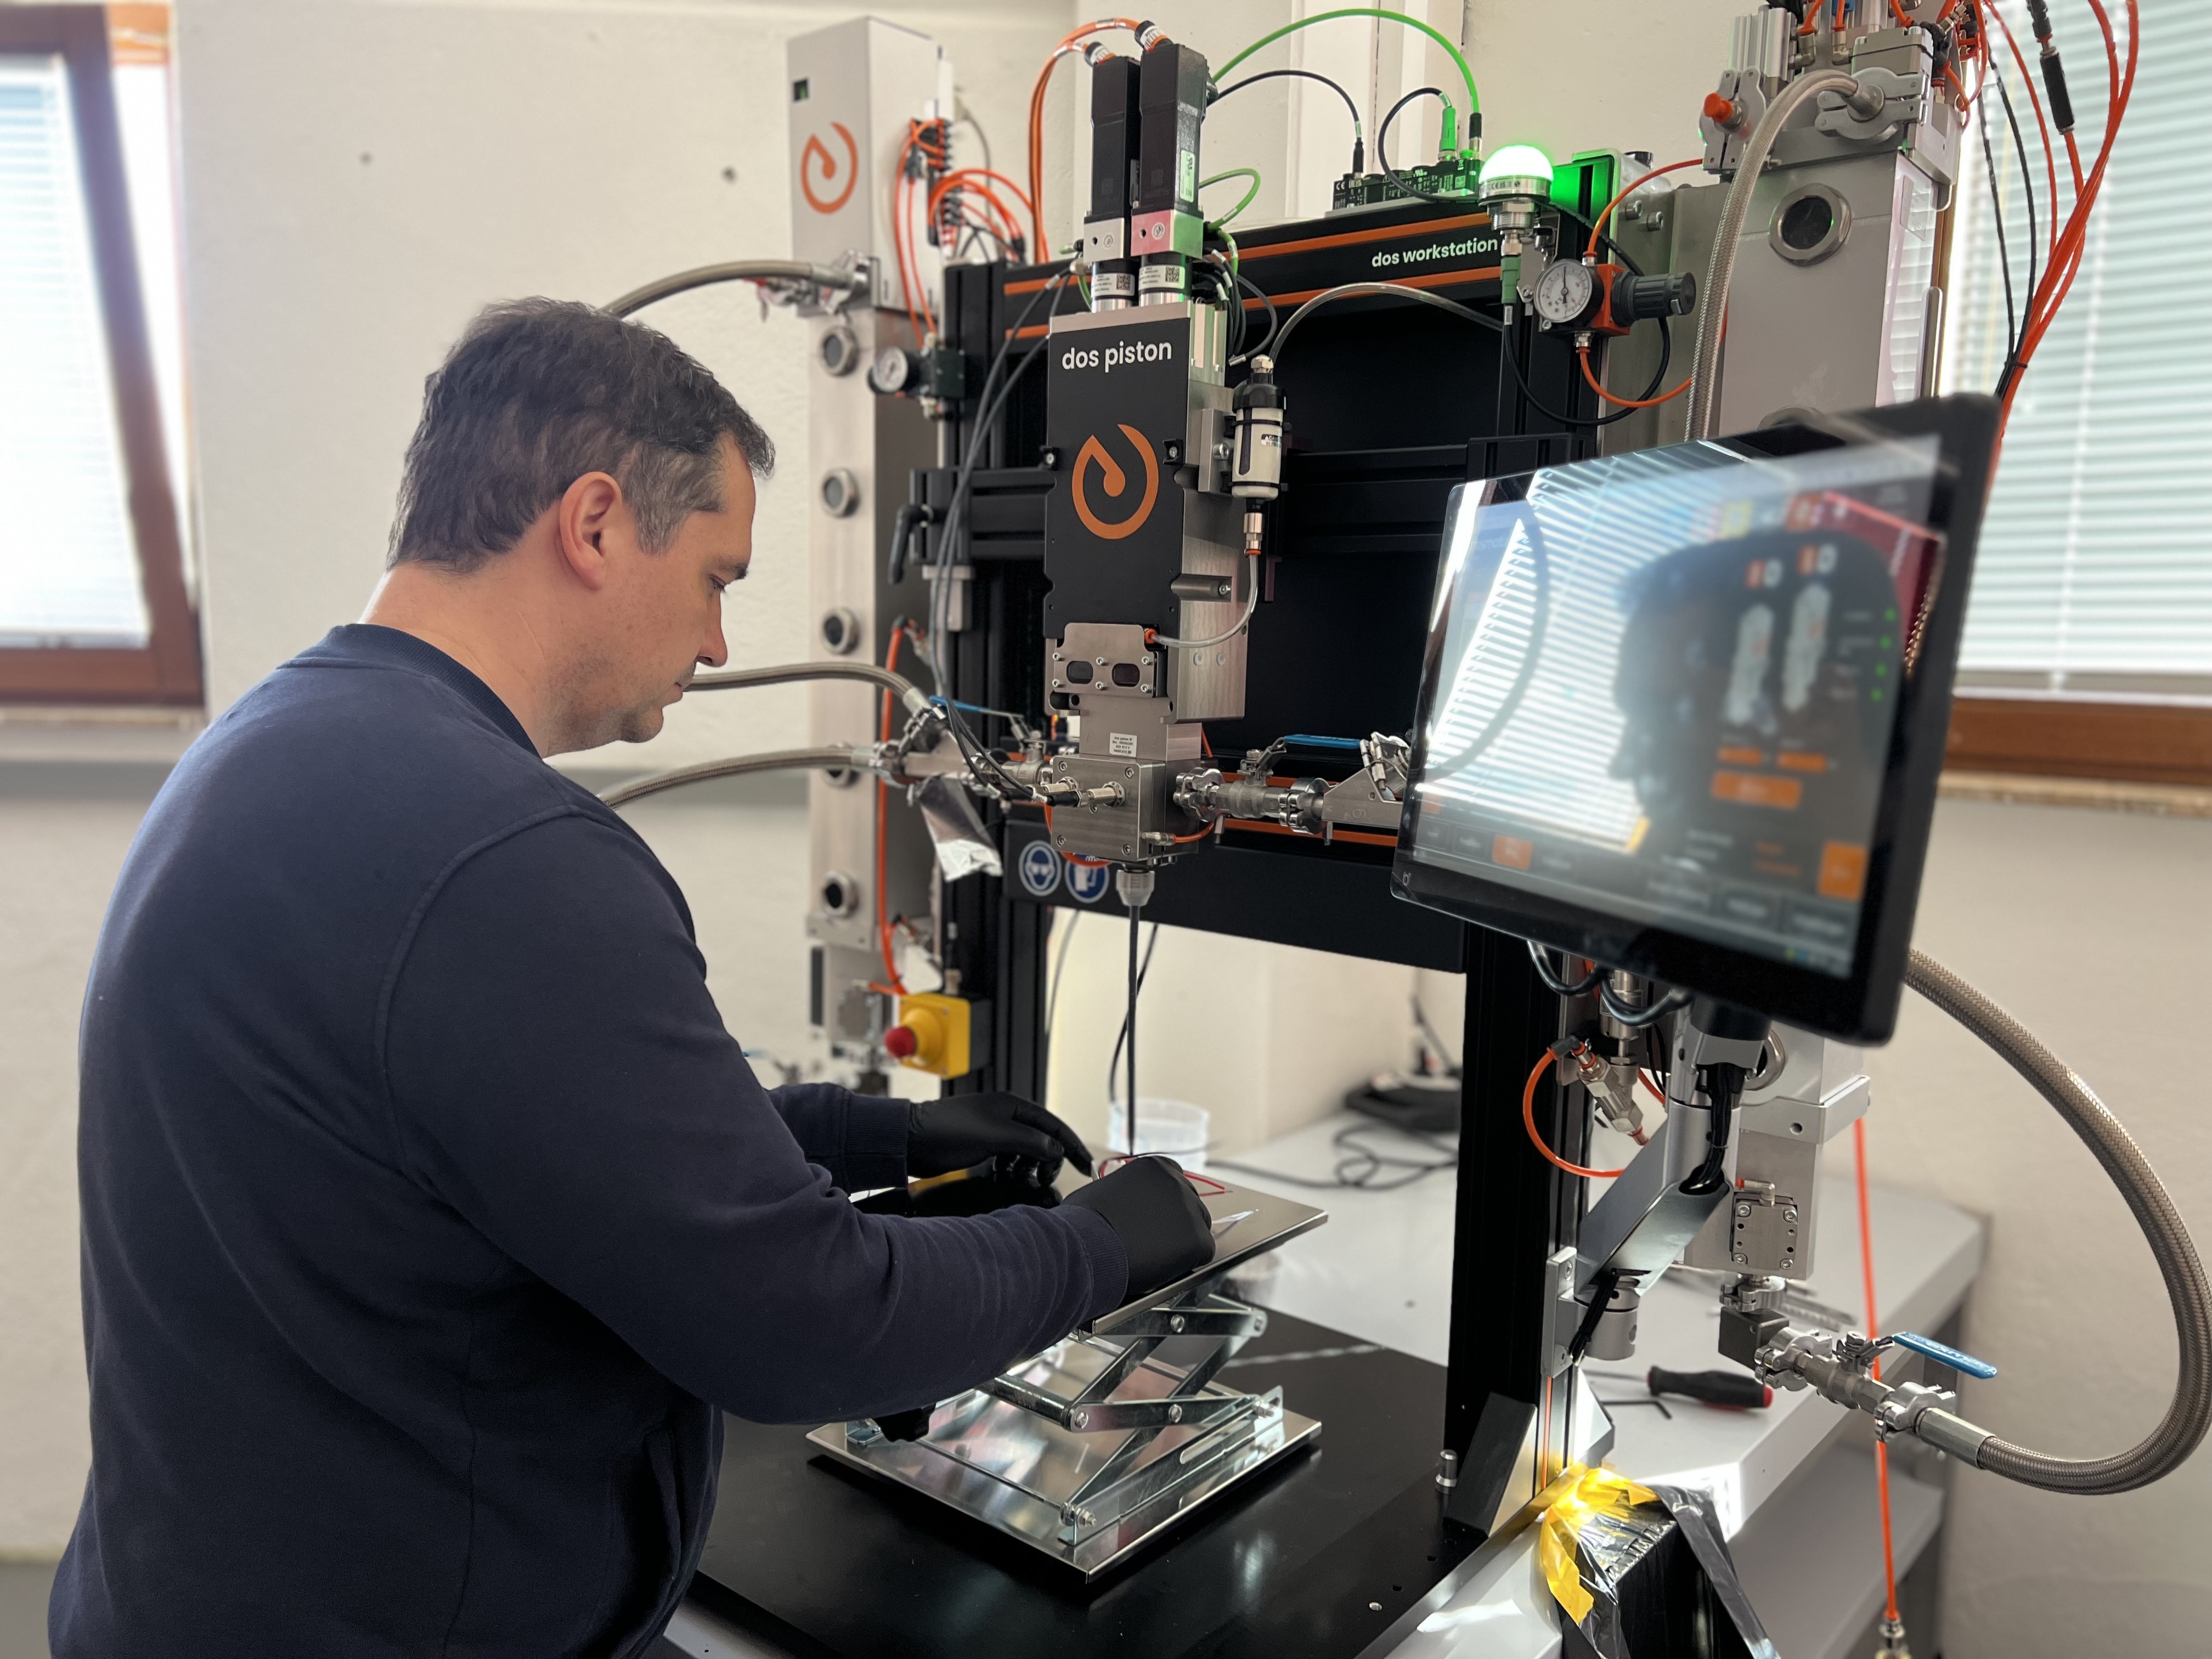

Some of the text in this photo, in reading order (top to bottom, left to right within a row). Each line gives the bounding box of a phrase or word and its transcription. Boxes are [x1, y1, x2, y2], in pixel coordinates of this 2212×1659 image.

[1372, 238, 1498, 267] dos workstation
[1062, 341, 1172, 373] dos piston
